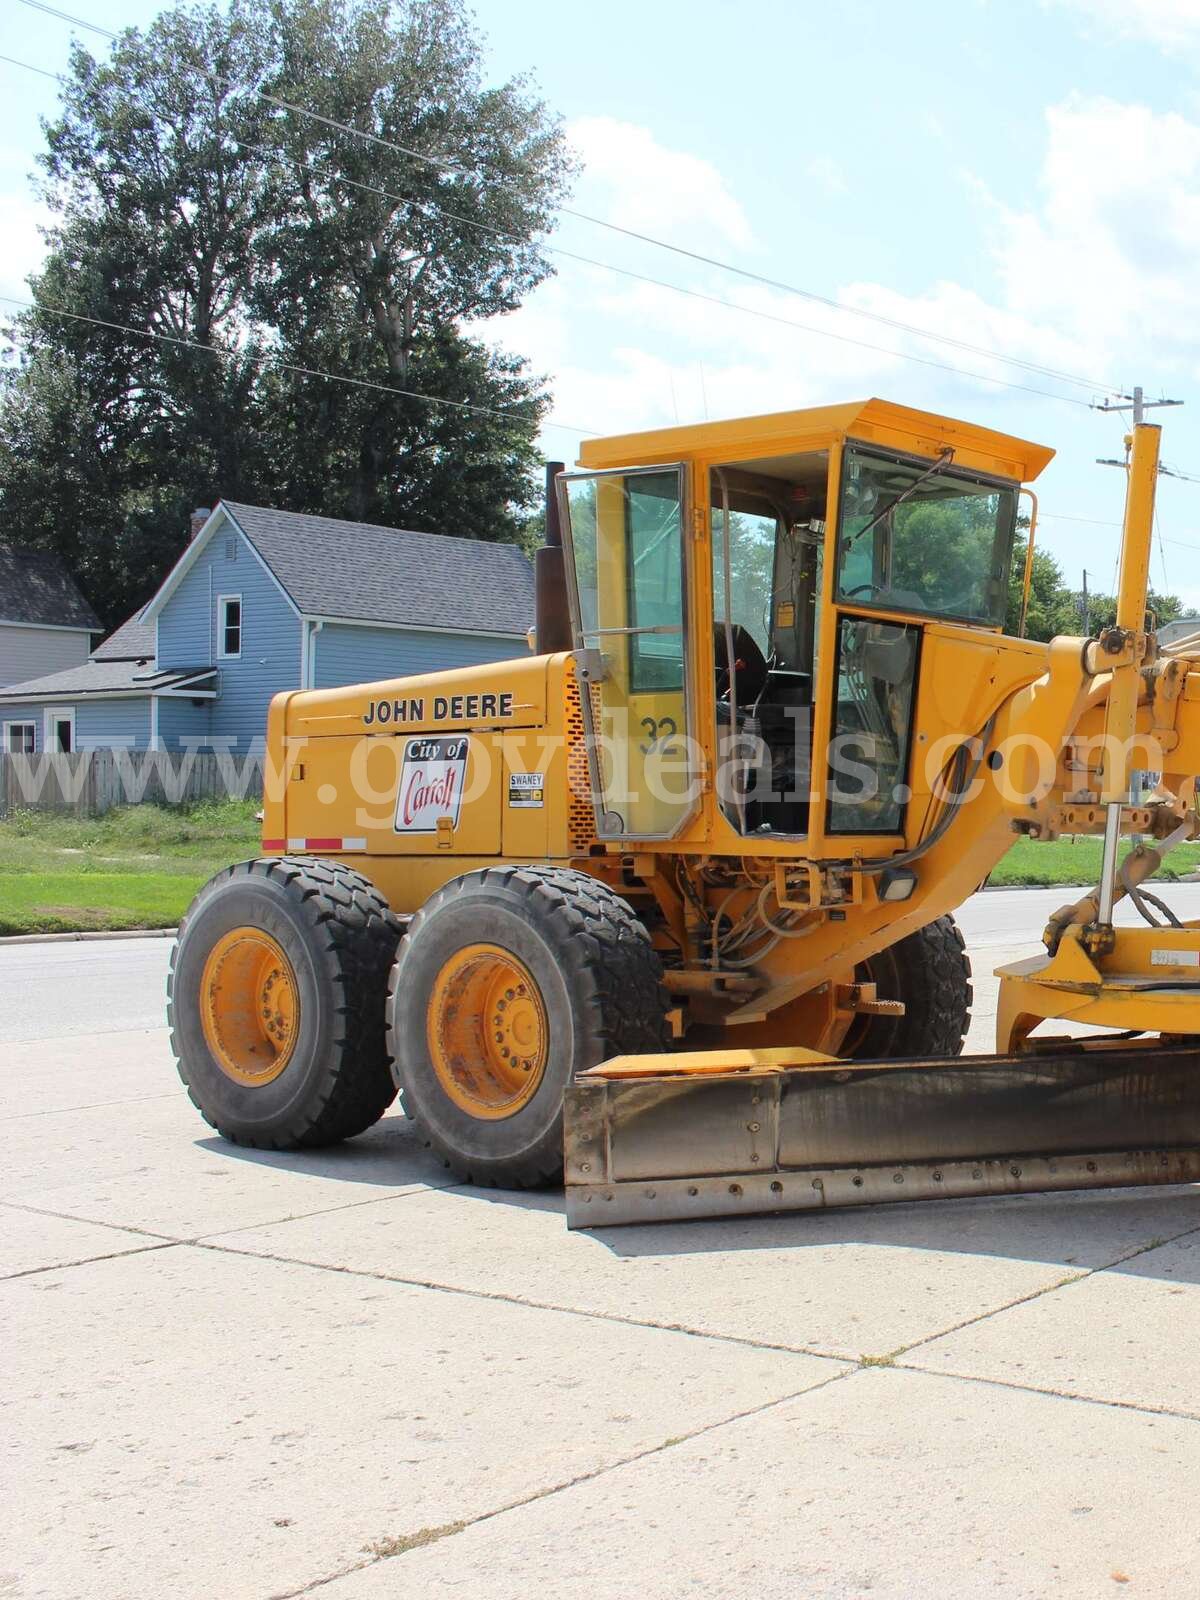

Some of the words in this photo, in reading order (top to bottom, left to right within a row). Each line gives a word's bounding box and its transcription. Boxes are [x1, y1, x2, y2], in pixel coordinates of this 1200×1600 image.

[363, 698, 424, 724] JOHN
[433, 693, 513, 720] DEERE
[407, 740, 441, 761] City
[446, 739, 467, 761] of
[640, 716, 677, 755] 32
[511, 775, 542, 785] SWANEY
[403, 767, 457, 826] Carroll
